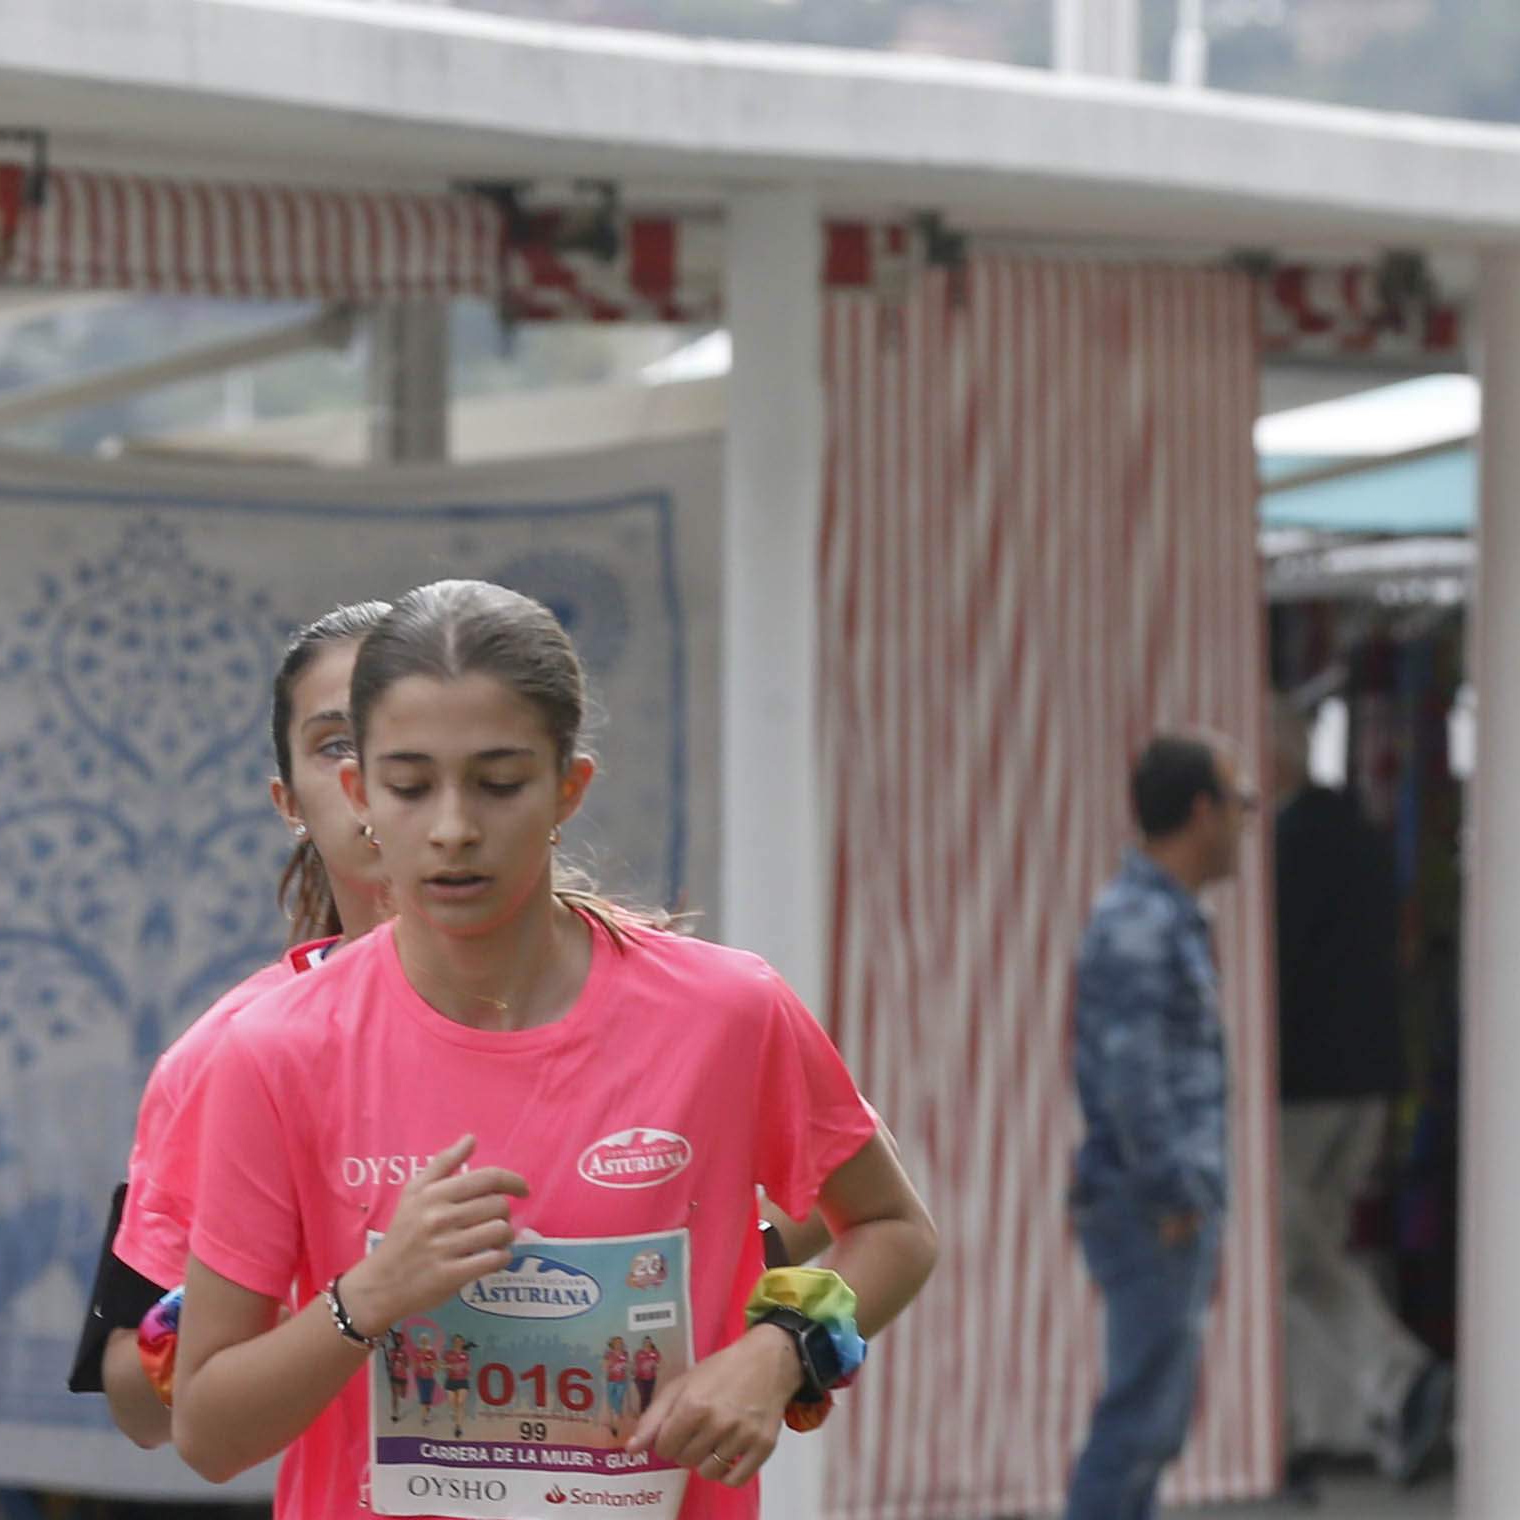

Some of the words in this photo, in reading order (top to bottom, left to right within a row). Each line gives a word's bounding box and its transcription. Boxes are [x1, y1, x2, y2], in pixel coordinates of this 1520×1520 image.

[632, 1252, 663, 1276] 20
[469, 1279, 592, 1306] ASTURIANA
[477, 1362, 595, 1412] 016
[520, 1421, 548, 1442] 99
[419, 1442, 490, 1463] CARRERA
[493, 1447, 514, 1463] DE
[517, 1448, 538, 1464] LA
[541, 1449, 594, 1467] MUJER
[408, 1474, 507, 1501] OYSHO
[570, 1487, 664, 1507] Santander
